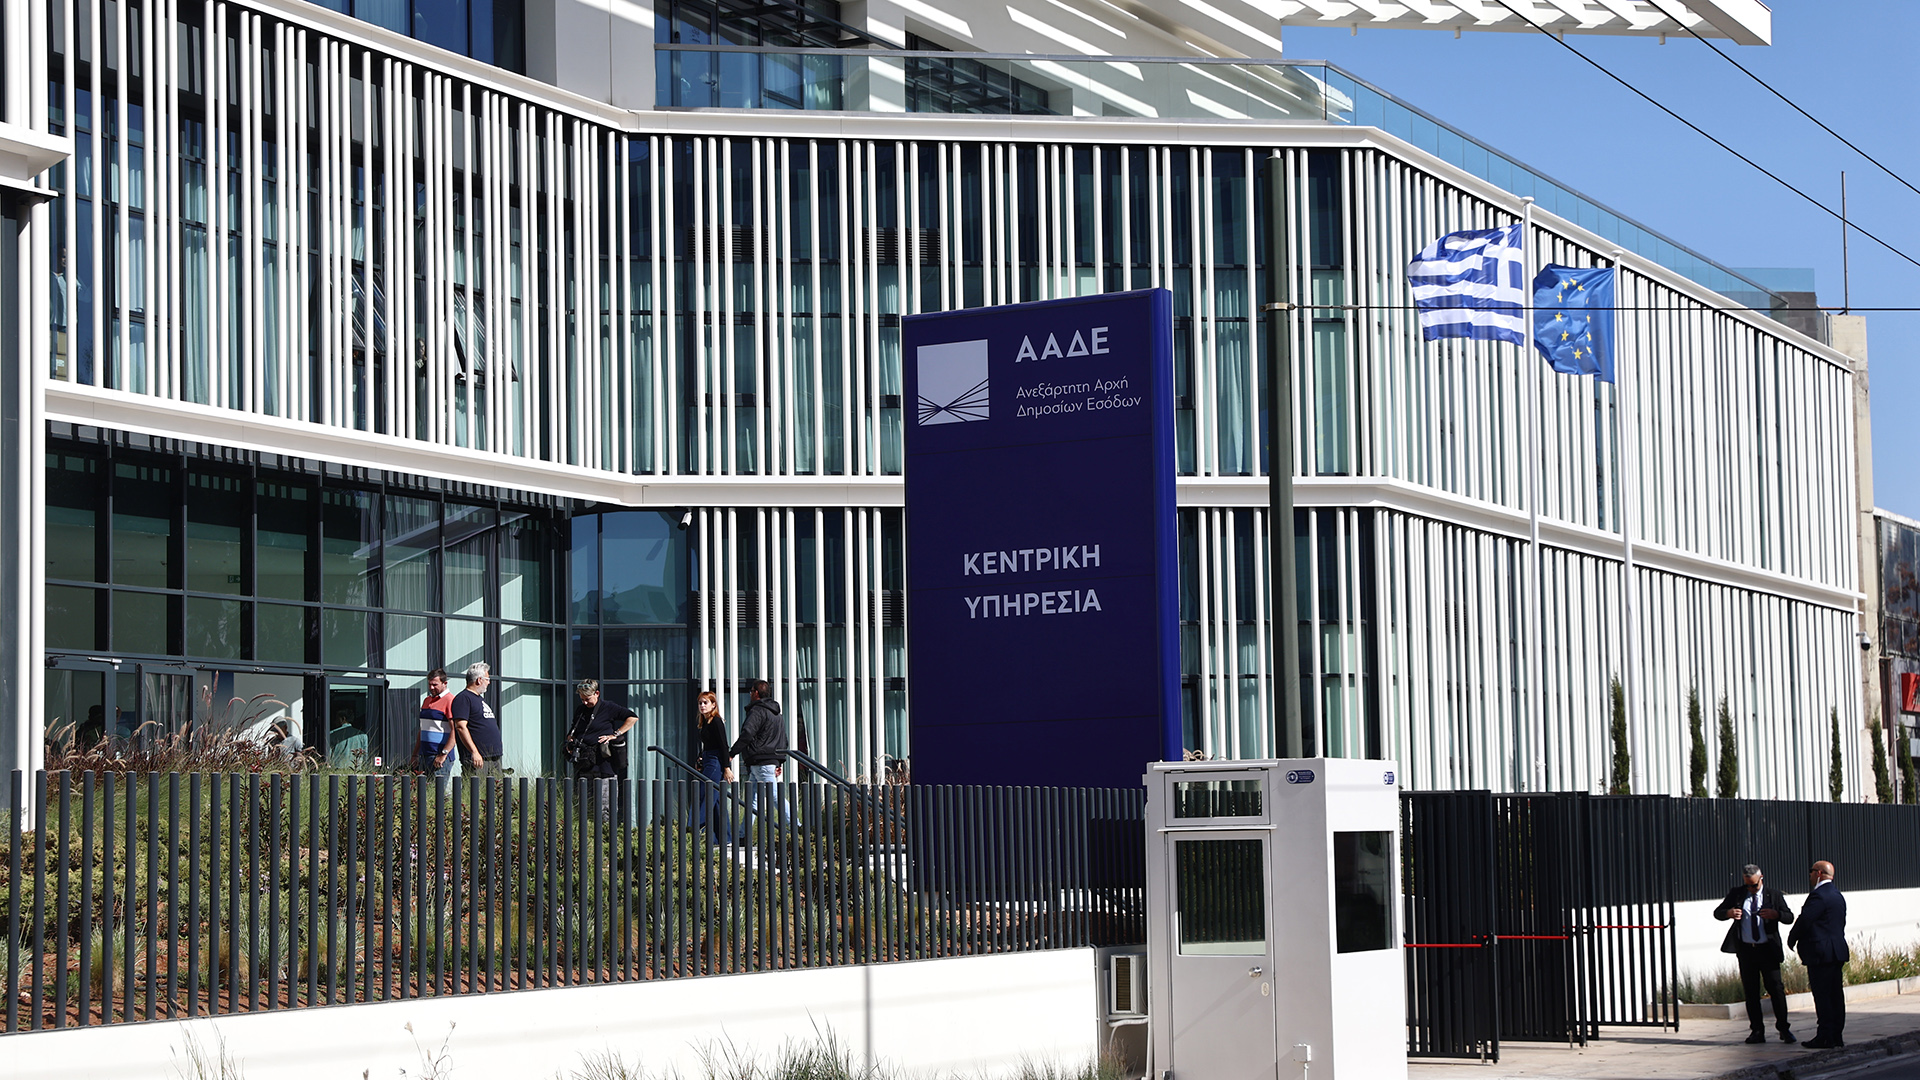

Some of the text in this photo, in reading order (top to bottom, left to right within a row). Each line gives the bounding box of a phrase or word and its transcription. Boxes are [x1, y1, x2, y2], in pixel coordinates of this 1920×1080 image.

[1015, 326, 1110, 363] ΑΑΔΕ
[1016, 376, 1129, 399] Ανεξάρτητη Αρχή
[1016, 394, 1142, 419] Δημοσίων Εσόδων
[963, 544, 1101, 576] ΚΕΝΤΡΙΚΗ
[964, 588, 1102, 619] ΥΠΗΡΕΣΙΑ
